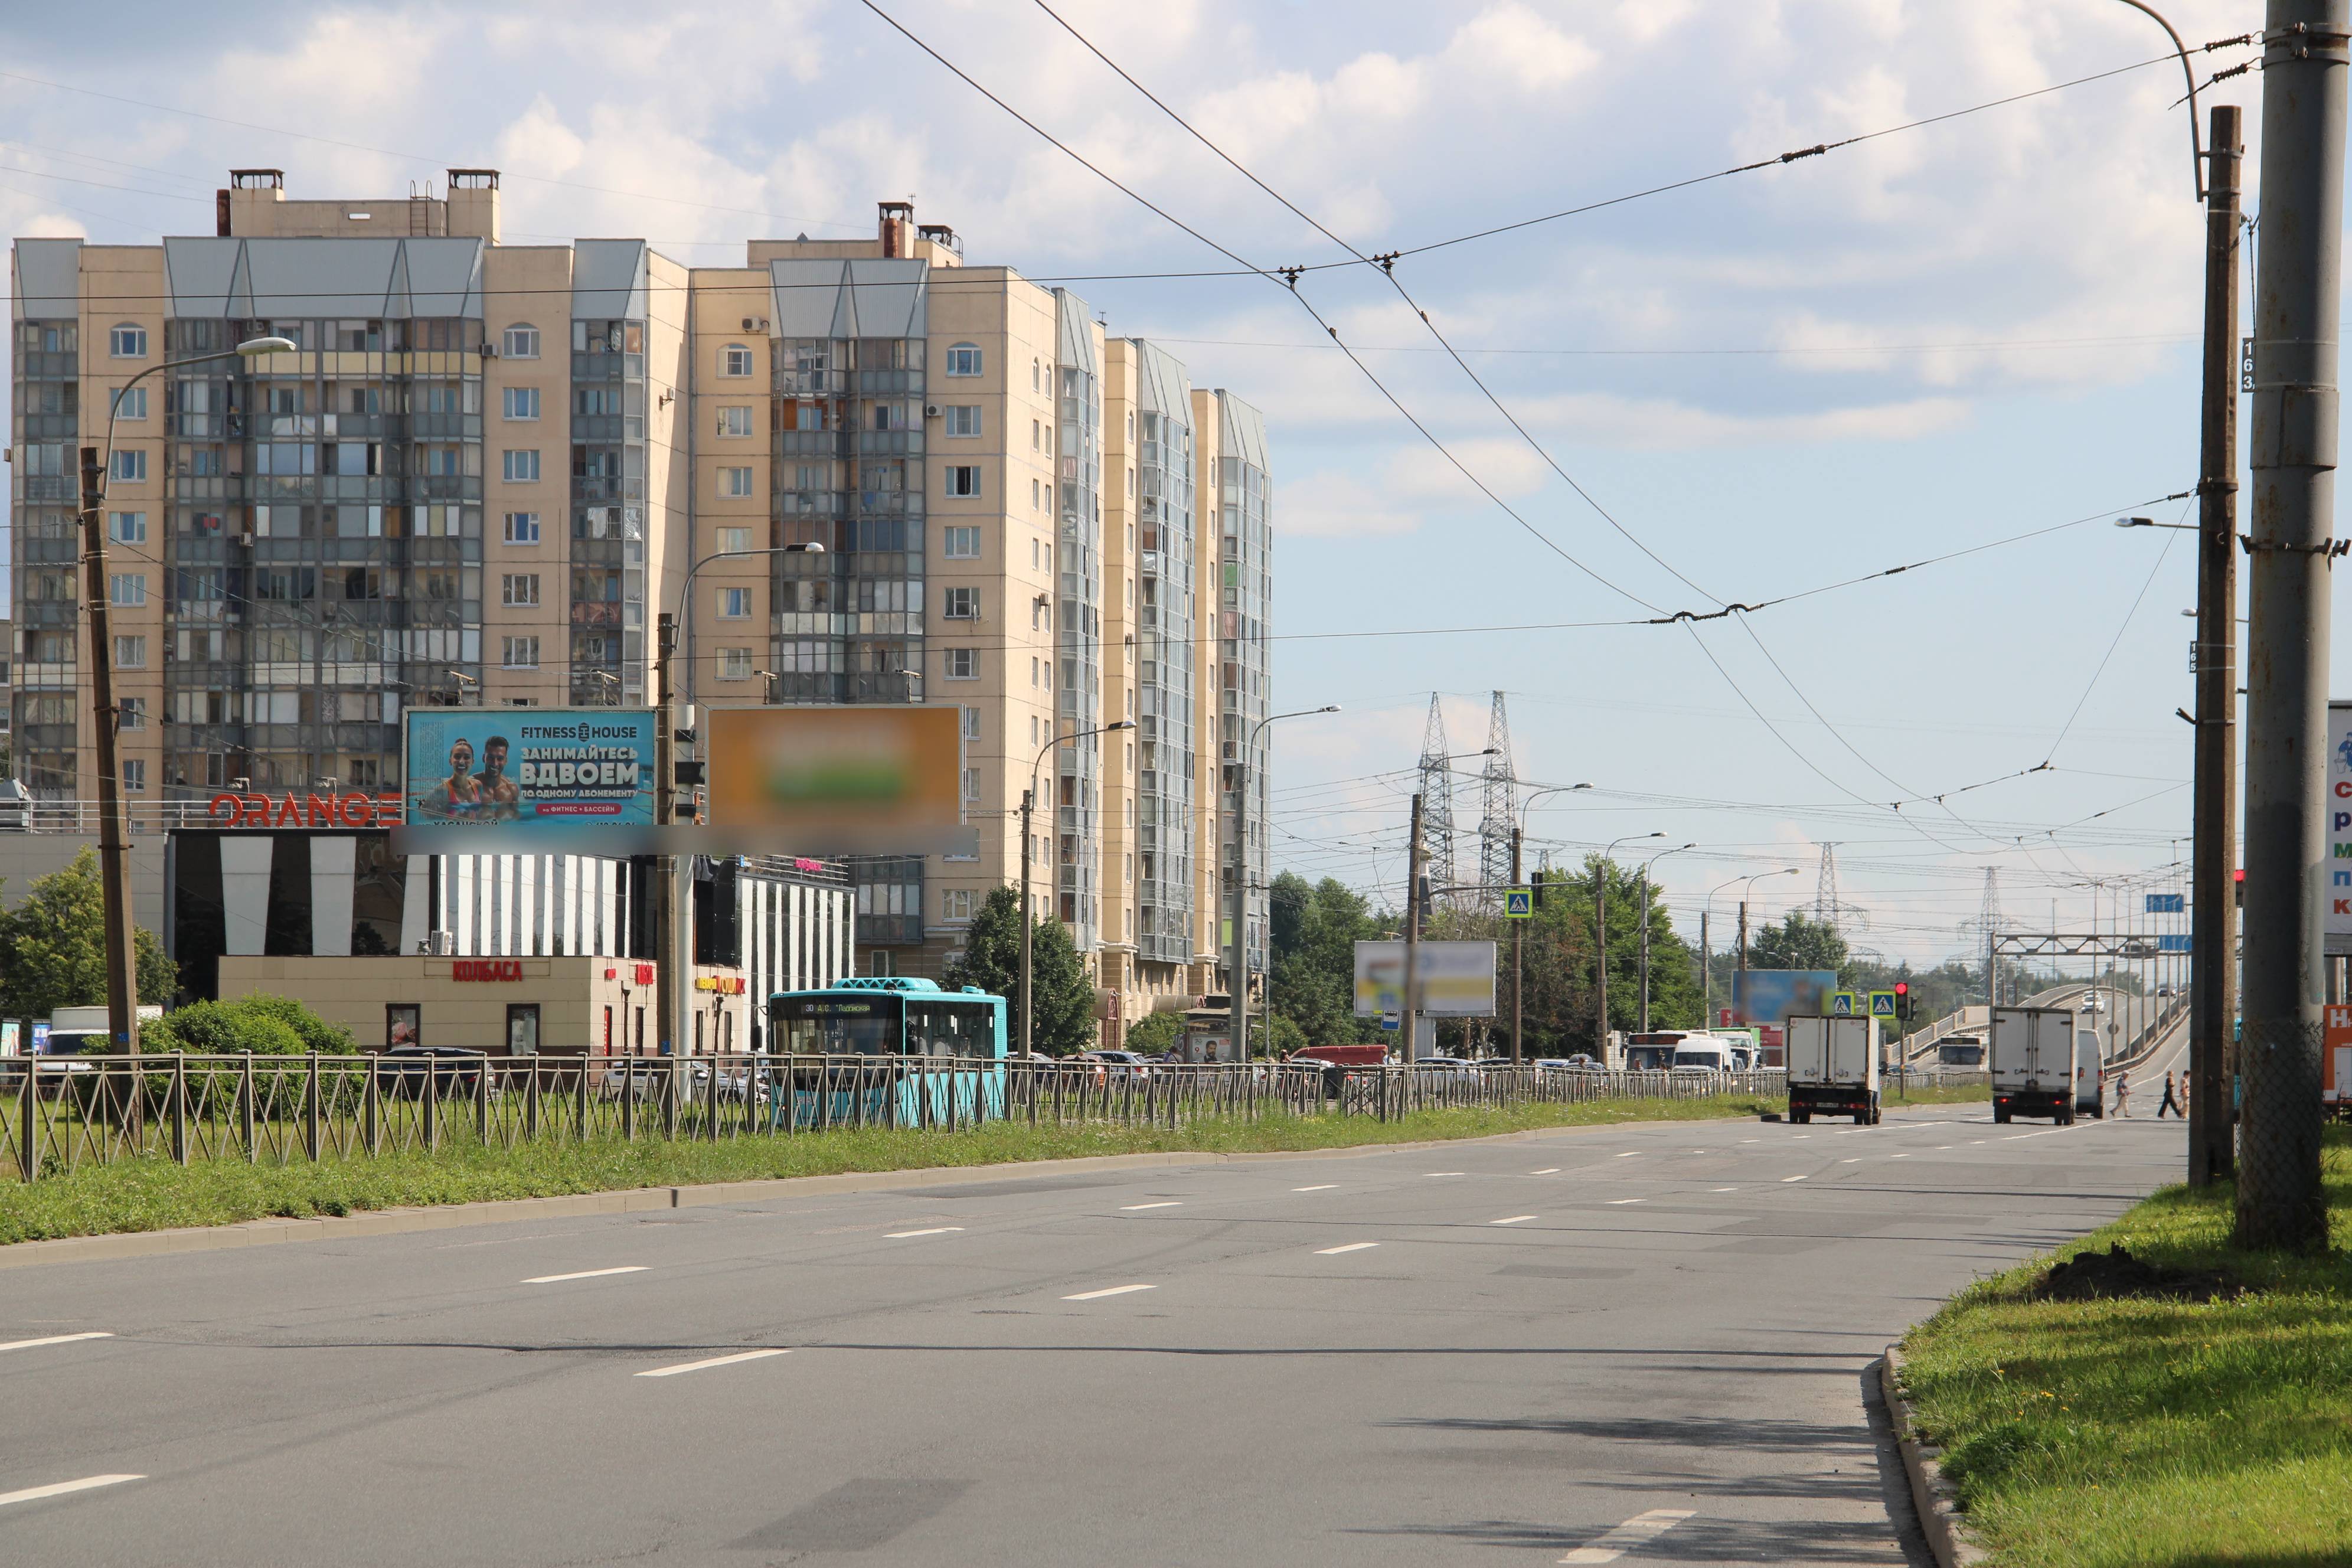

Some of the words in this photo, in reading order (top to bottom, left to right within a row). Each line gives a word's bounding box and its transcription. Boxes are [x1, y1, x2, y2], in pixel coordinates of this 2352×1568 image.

[2243, 341, 2253, 390] 163
[521, 727, 576, 738] FITNESS
[592, 727, 637, 738] HOUSE
[520, 744, 638, 759] ЗАНИМАЙТЕСЬ
[520, 762, 639, 787] ВДВОЕМ
[536, 790, 577, 798] ОДНОМУ
[209, 792, 402, 827] ORANGE
[453, 961, 522, 982] КОЛБАСА
